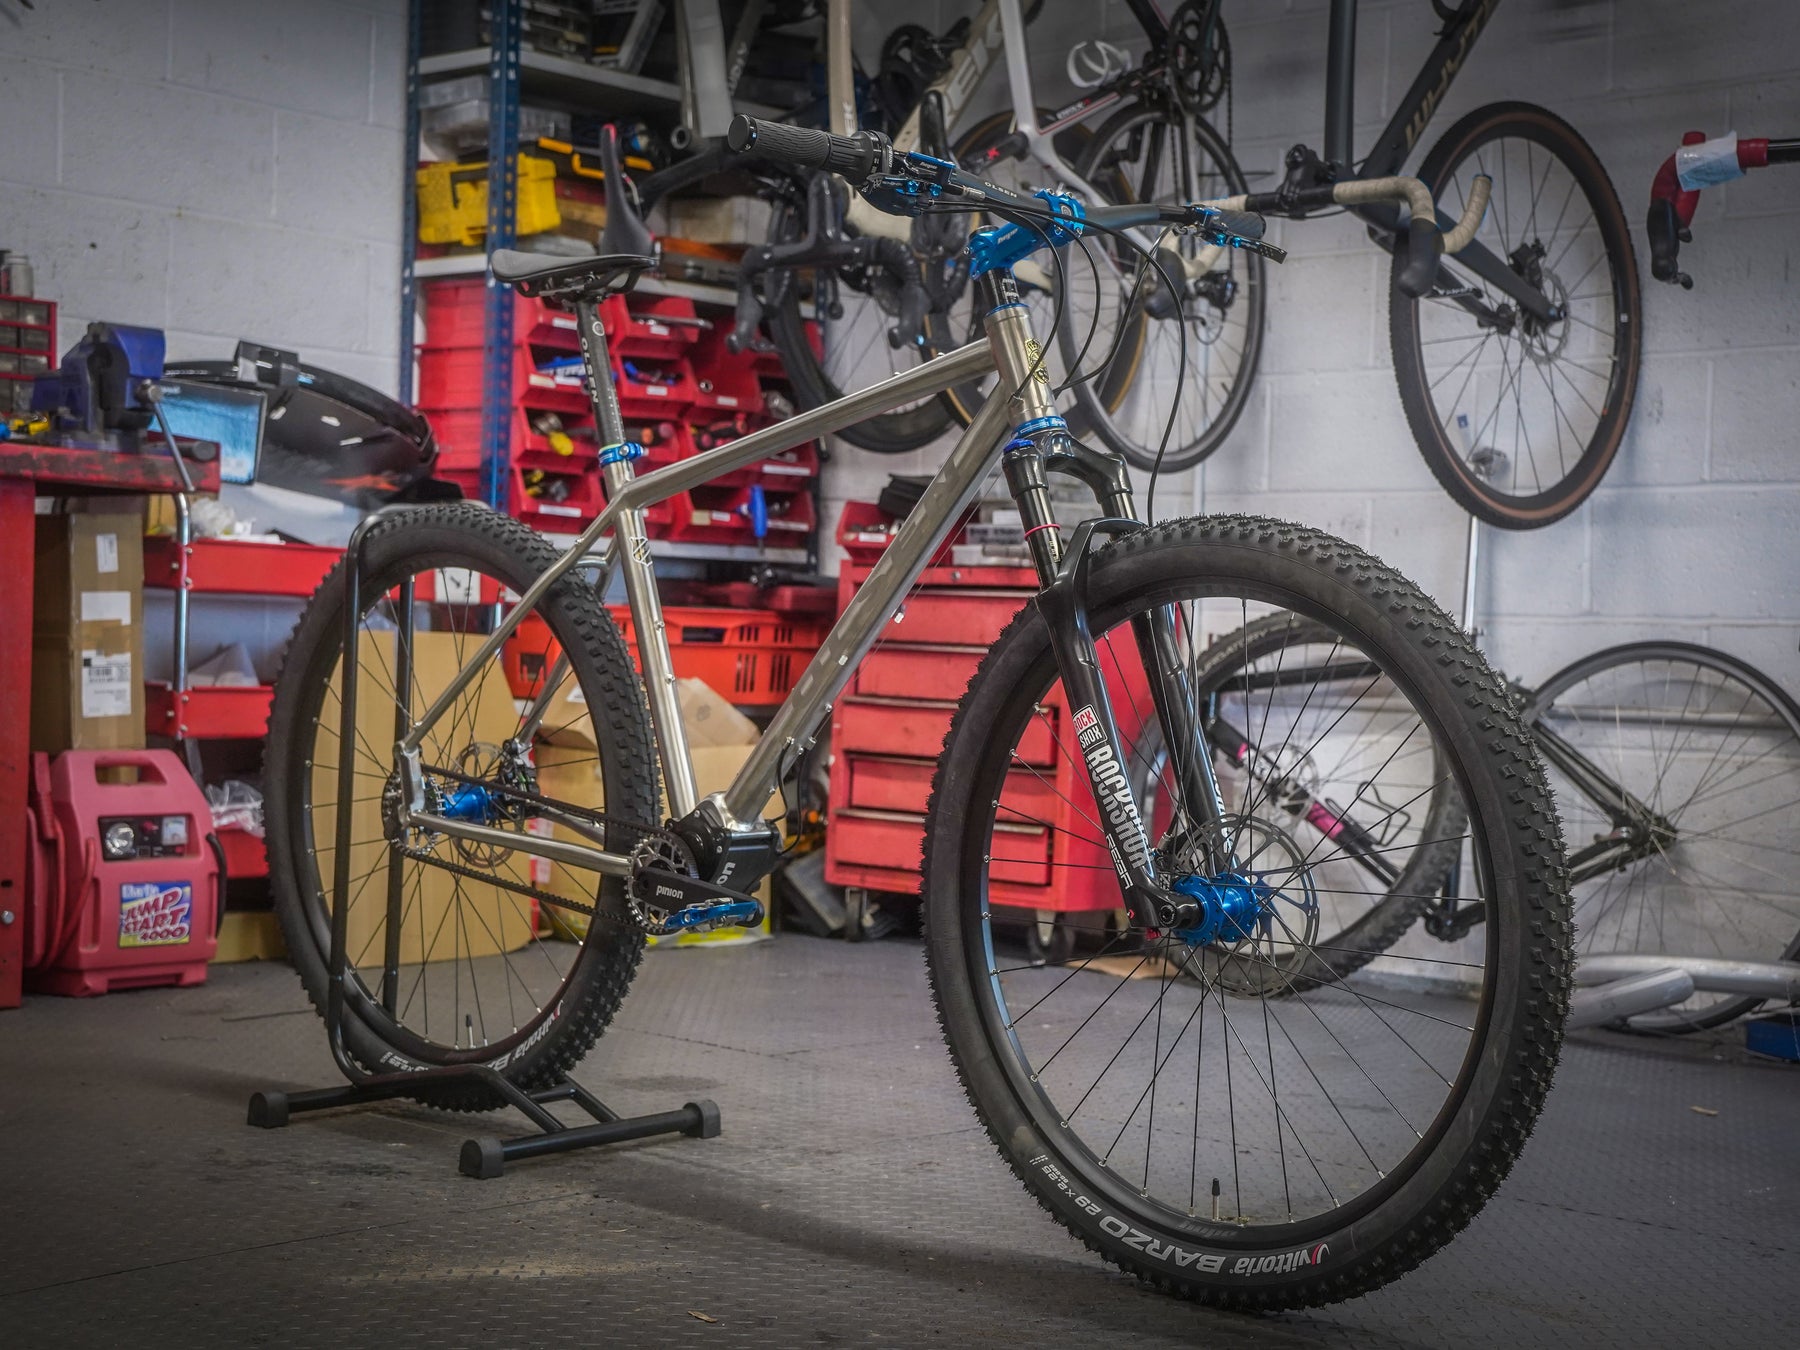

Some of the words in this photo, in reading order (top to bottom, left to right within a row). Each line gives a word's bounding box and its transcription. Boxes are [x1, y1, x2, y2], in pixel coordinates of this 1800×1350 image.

[984, 180, 1018, 199] OLSEN
[581, 336, 599, 404] OLSEN
[1079, 726, 1102, 749] SHOX
[1086, 744, 1150, 869] ROCKSHOX
[1106, 833, 1133, 890] REBA
[125, 890, 180, 920] JUMP
[656, 885, 683, 900] pinion
[124, 907, 185, 933] START
[141, 926, 185, 941] 4000
[1041, 1165, 1069, 1190] 2.25
[1074, 1195, 1102, 1216] 29
[1099, 1215, 1226, 1274] BARZO
[1233, 1249, 1312, 1277] vittoria
